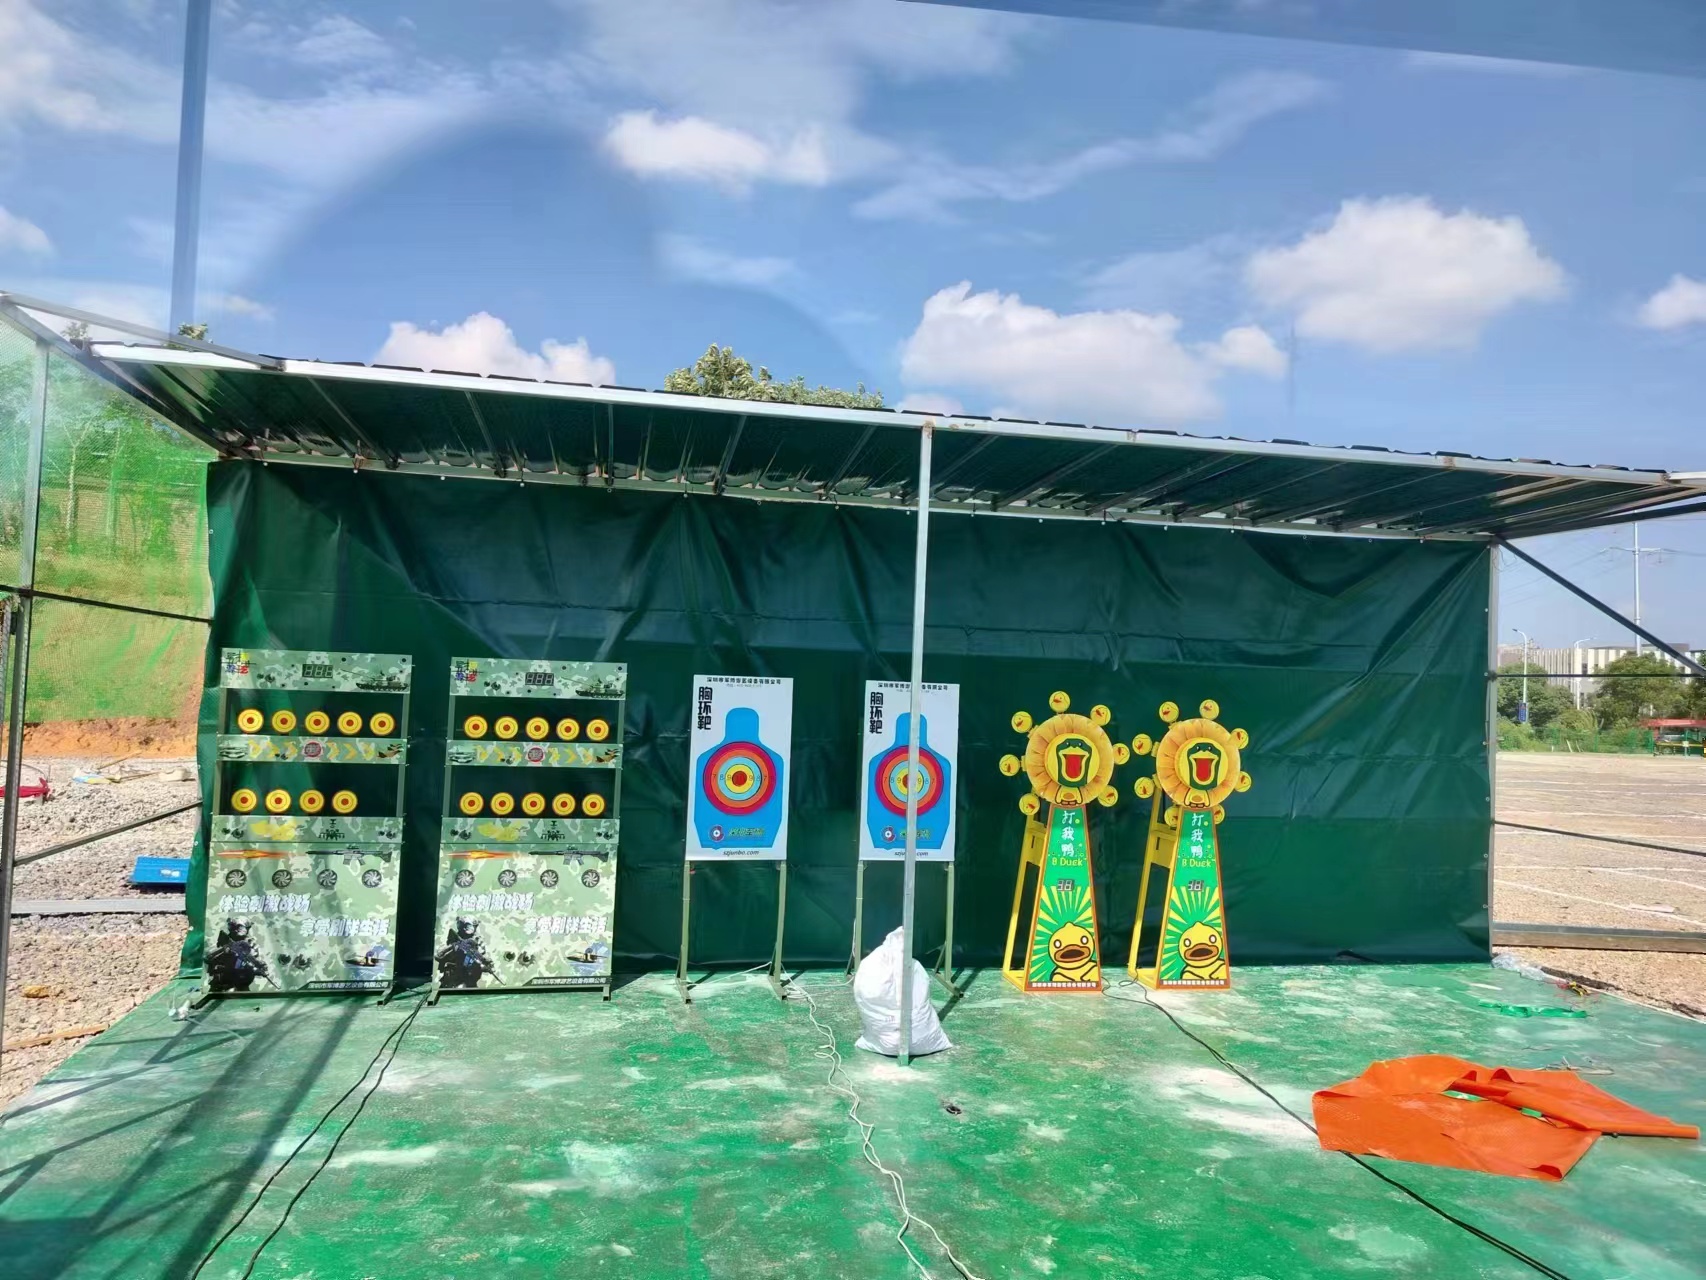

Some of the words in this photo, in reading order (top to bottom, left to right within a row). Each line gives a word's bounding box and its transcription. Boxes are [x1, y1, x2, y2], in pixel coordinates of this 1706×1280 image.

[697, 686, 713, 730] 胸环靶
[869, 692, 884, 734] 胸环靶
[1061, 810, 1076, 857] 打我鸭
[1191, 813, 1205, 859] 打我鸭
[1060, 857, 1083, 866] Duck
[1189, 858, 1211, 868] Duck
[218, 893, 312, 913] 体验刺激战场
[448, 893, 534, 912] 体验刺激战场
[300, 917, 391, 937] 享受别样生活
[523, 916, 608, 935] 享受别样生活
